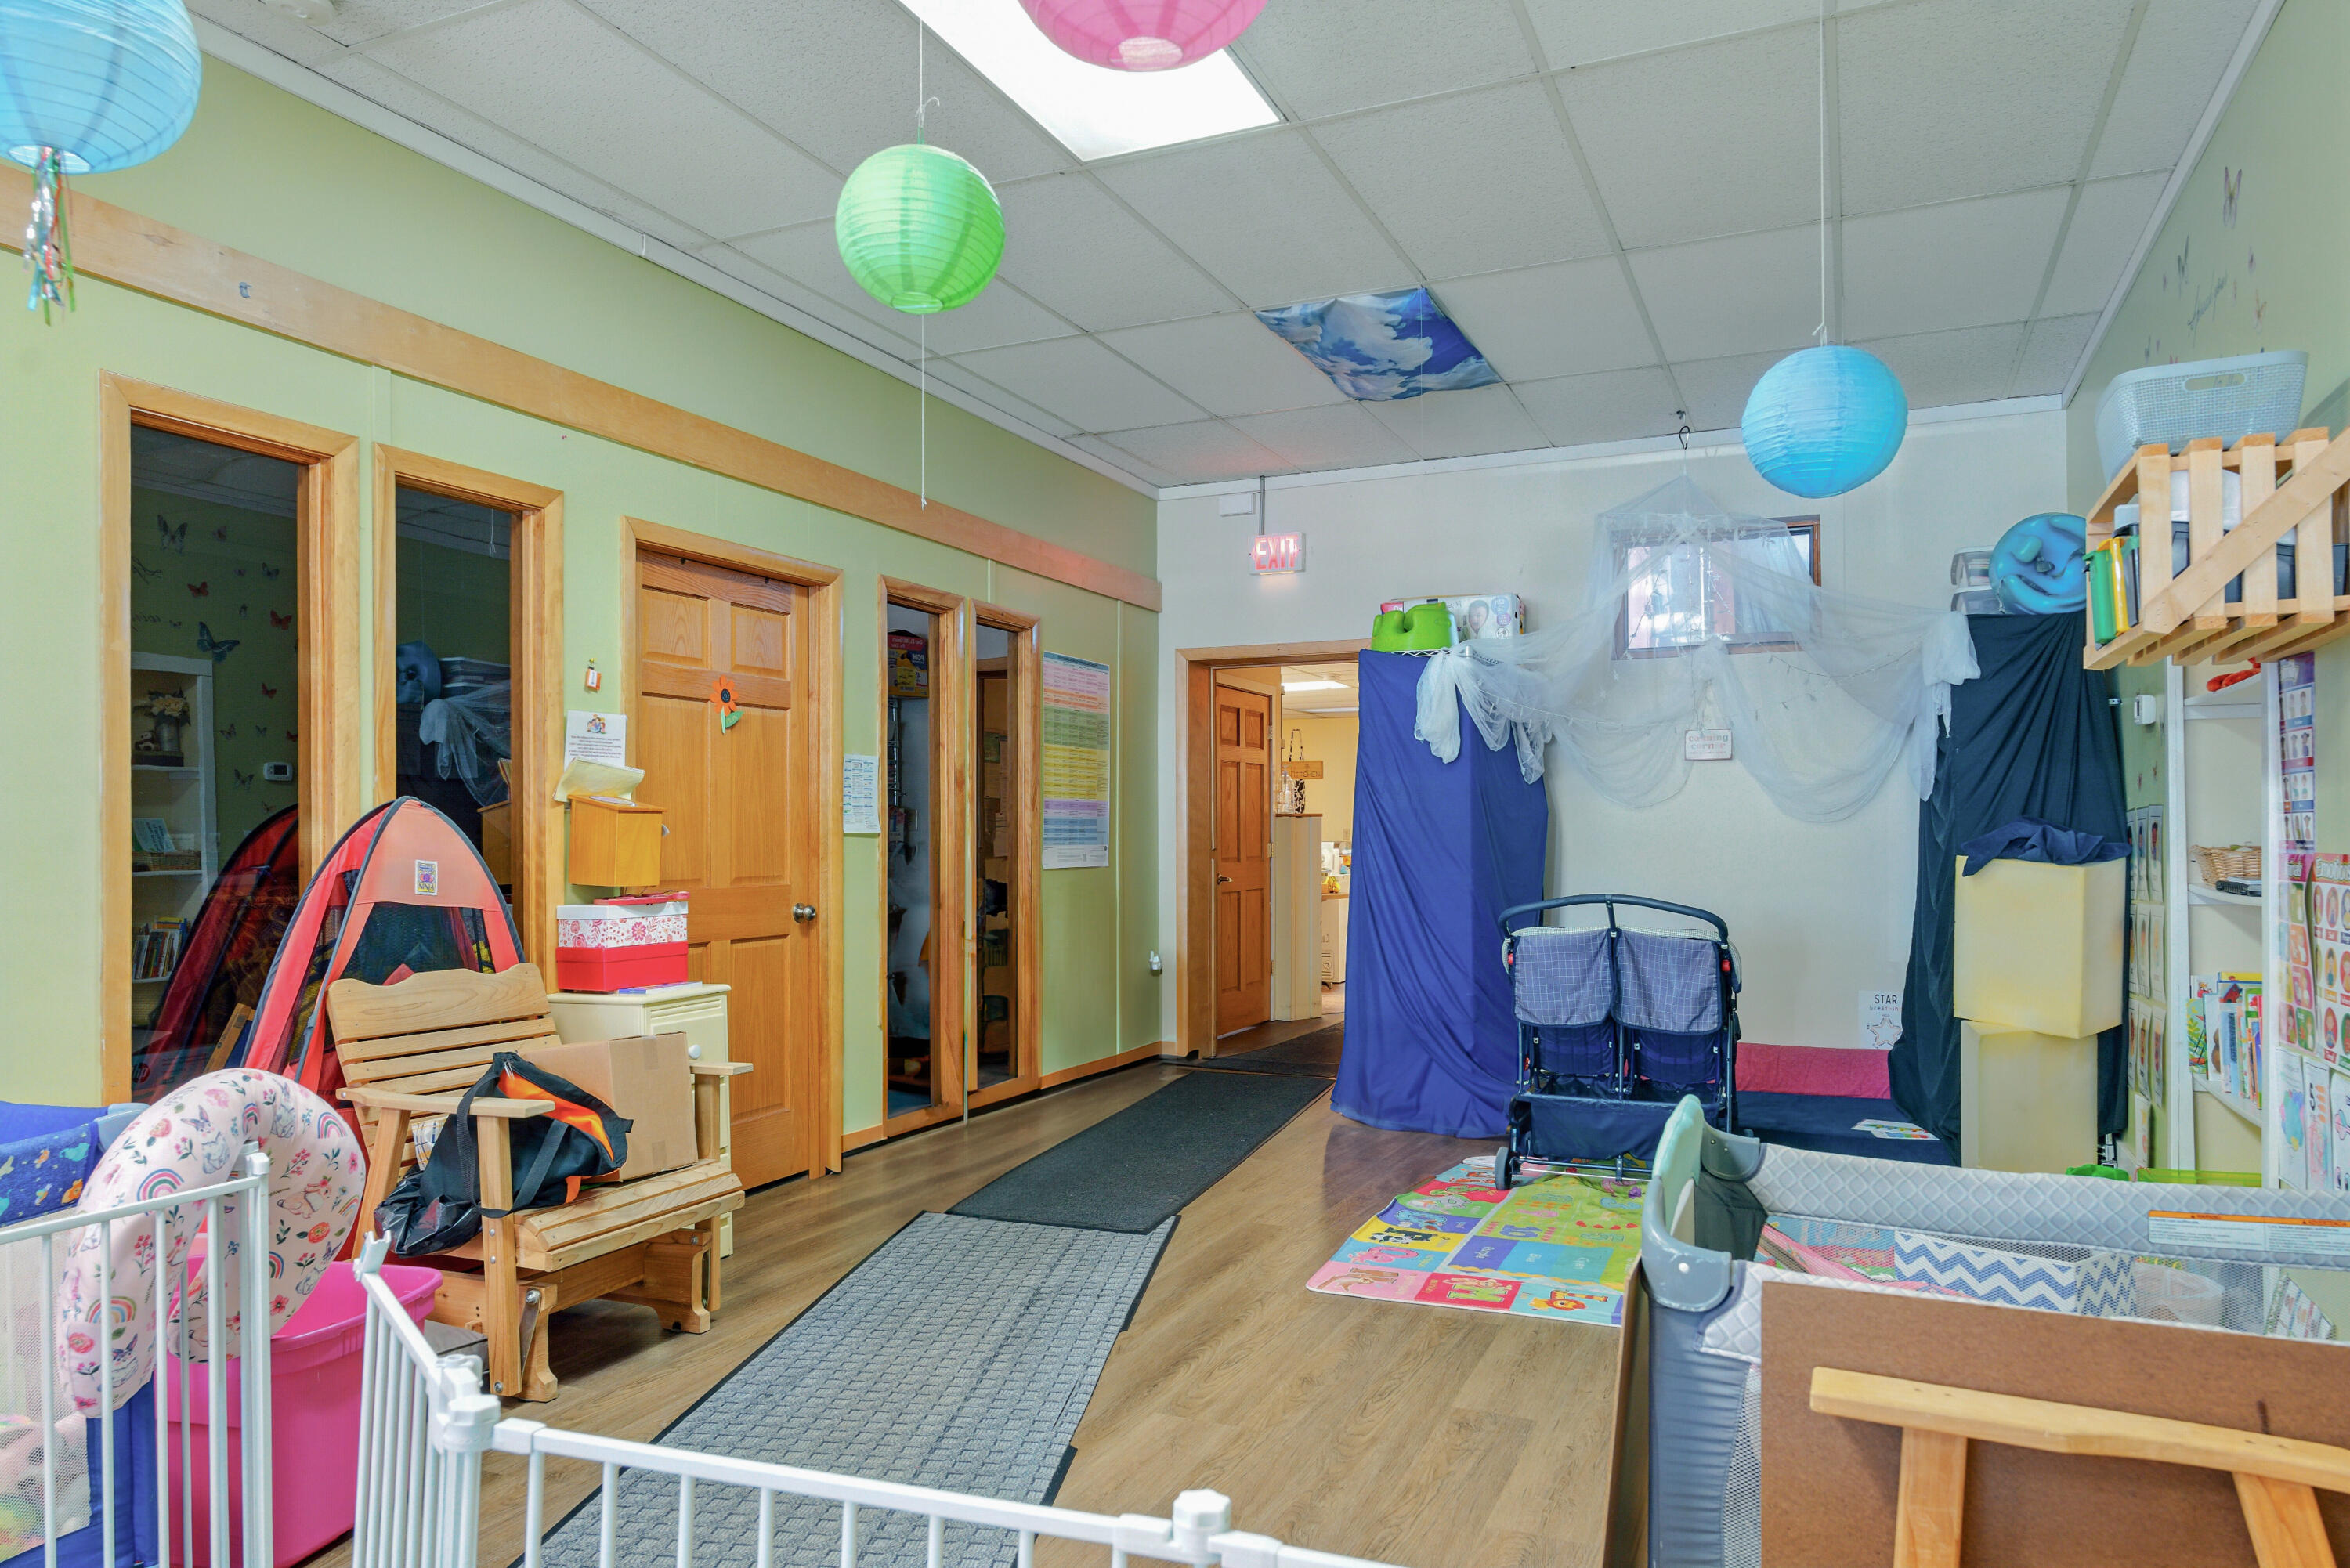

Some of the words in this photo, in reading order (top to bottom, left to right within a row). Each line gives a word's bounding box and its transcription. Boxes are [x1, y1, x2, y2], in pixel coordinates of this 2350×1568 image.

[1255, 534, 1298, 570] EXIT
[1875, 994, 1897, 1004] STAR
[1476, 1247, 1495, 1259] Purple
[1573, 1257, 1589, 1269] Cyan
